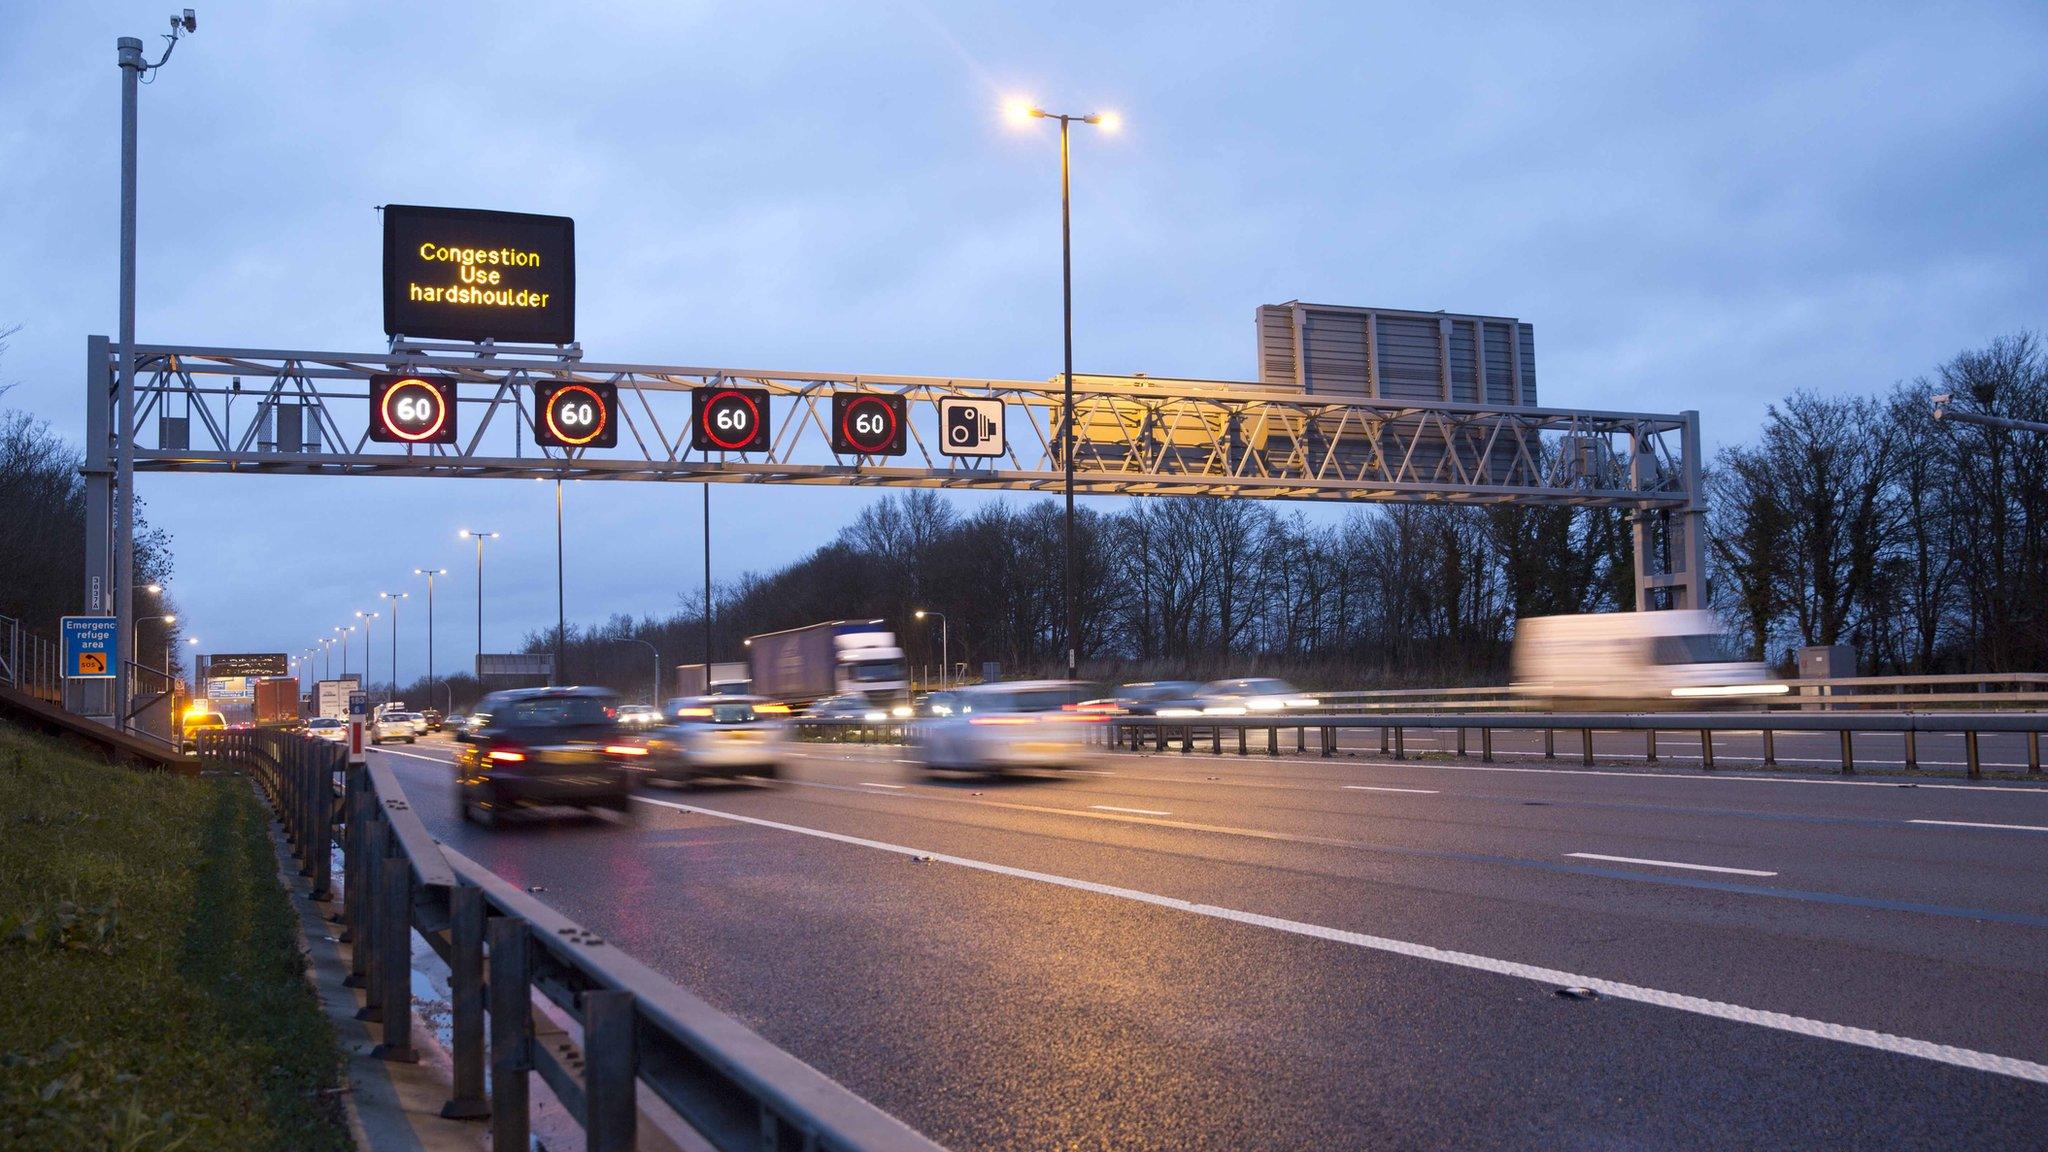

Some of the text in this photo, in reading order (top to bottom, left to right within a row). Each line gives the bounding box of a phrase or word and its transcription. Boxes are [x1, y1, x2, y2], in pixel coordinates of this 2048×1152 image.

[420, 243, 540, 266] Congestion
[461, 265, 500, 285] Use
[410, 283, 549, 307] hardshoulder
[397, 398, 430, 420] 60
[561, 404, 592, 425] 60
[717, 409, 746, 429] 60
[856, 414, 884, 434] 60
[66, 621, 117, 631] Emergenc
[77, 631, 109, 640] refuge
